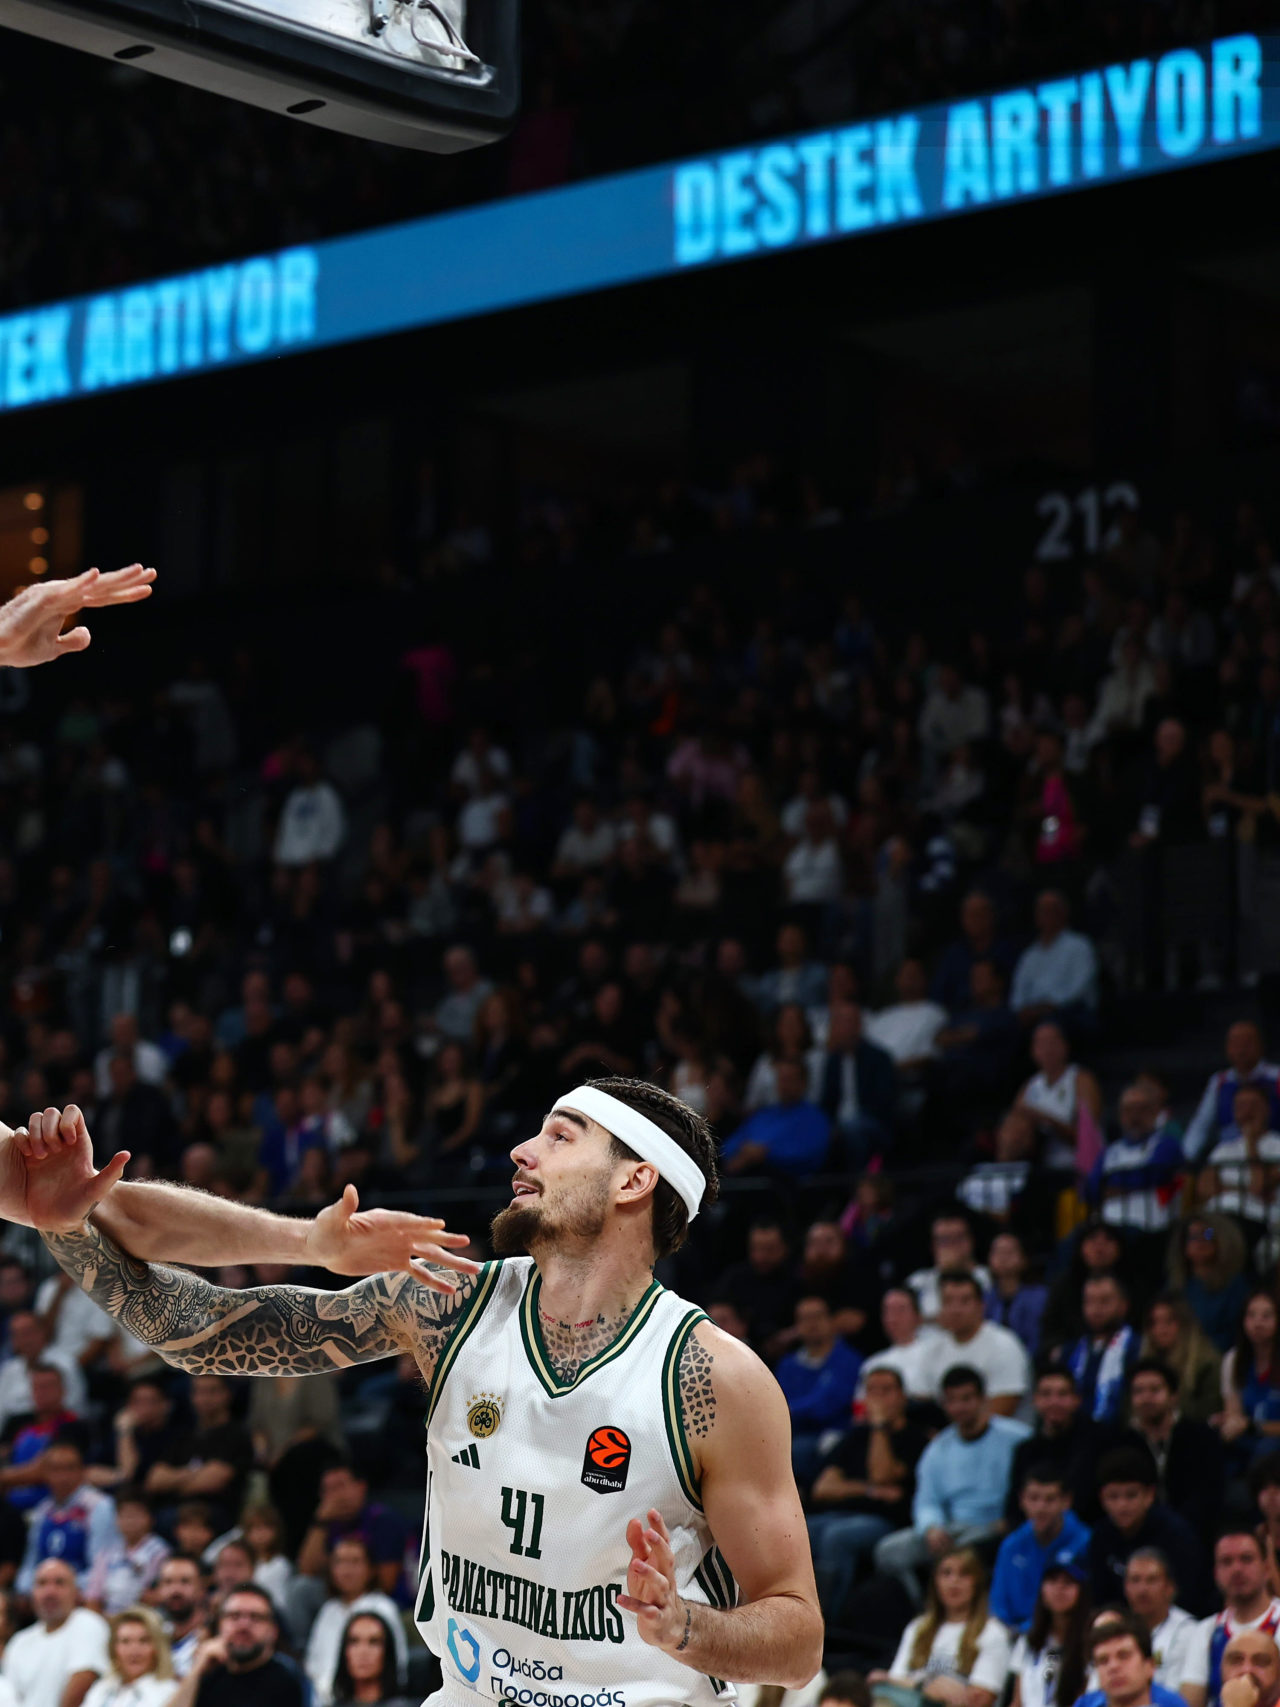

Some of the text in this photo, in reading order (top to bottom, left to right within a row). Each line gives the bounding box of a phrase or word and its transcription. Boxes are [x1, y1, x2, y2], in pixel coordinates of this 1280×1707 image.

[674, 33, 1261, 265] DESTEK ARTIYOR
[80, 247, 317, 391] ARTIYOR
[500, 1486, 545, 1560] 41
[583, 1475, 623, 1489] abu dhabi
[441, 1548, 625, 1644] PANATHINAIKOS
[492, 1648, 563, 1680] Ομάδα
